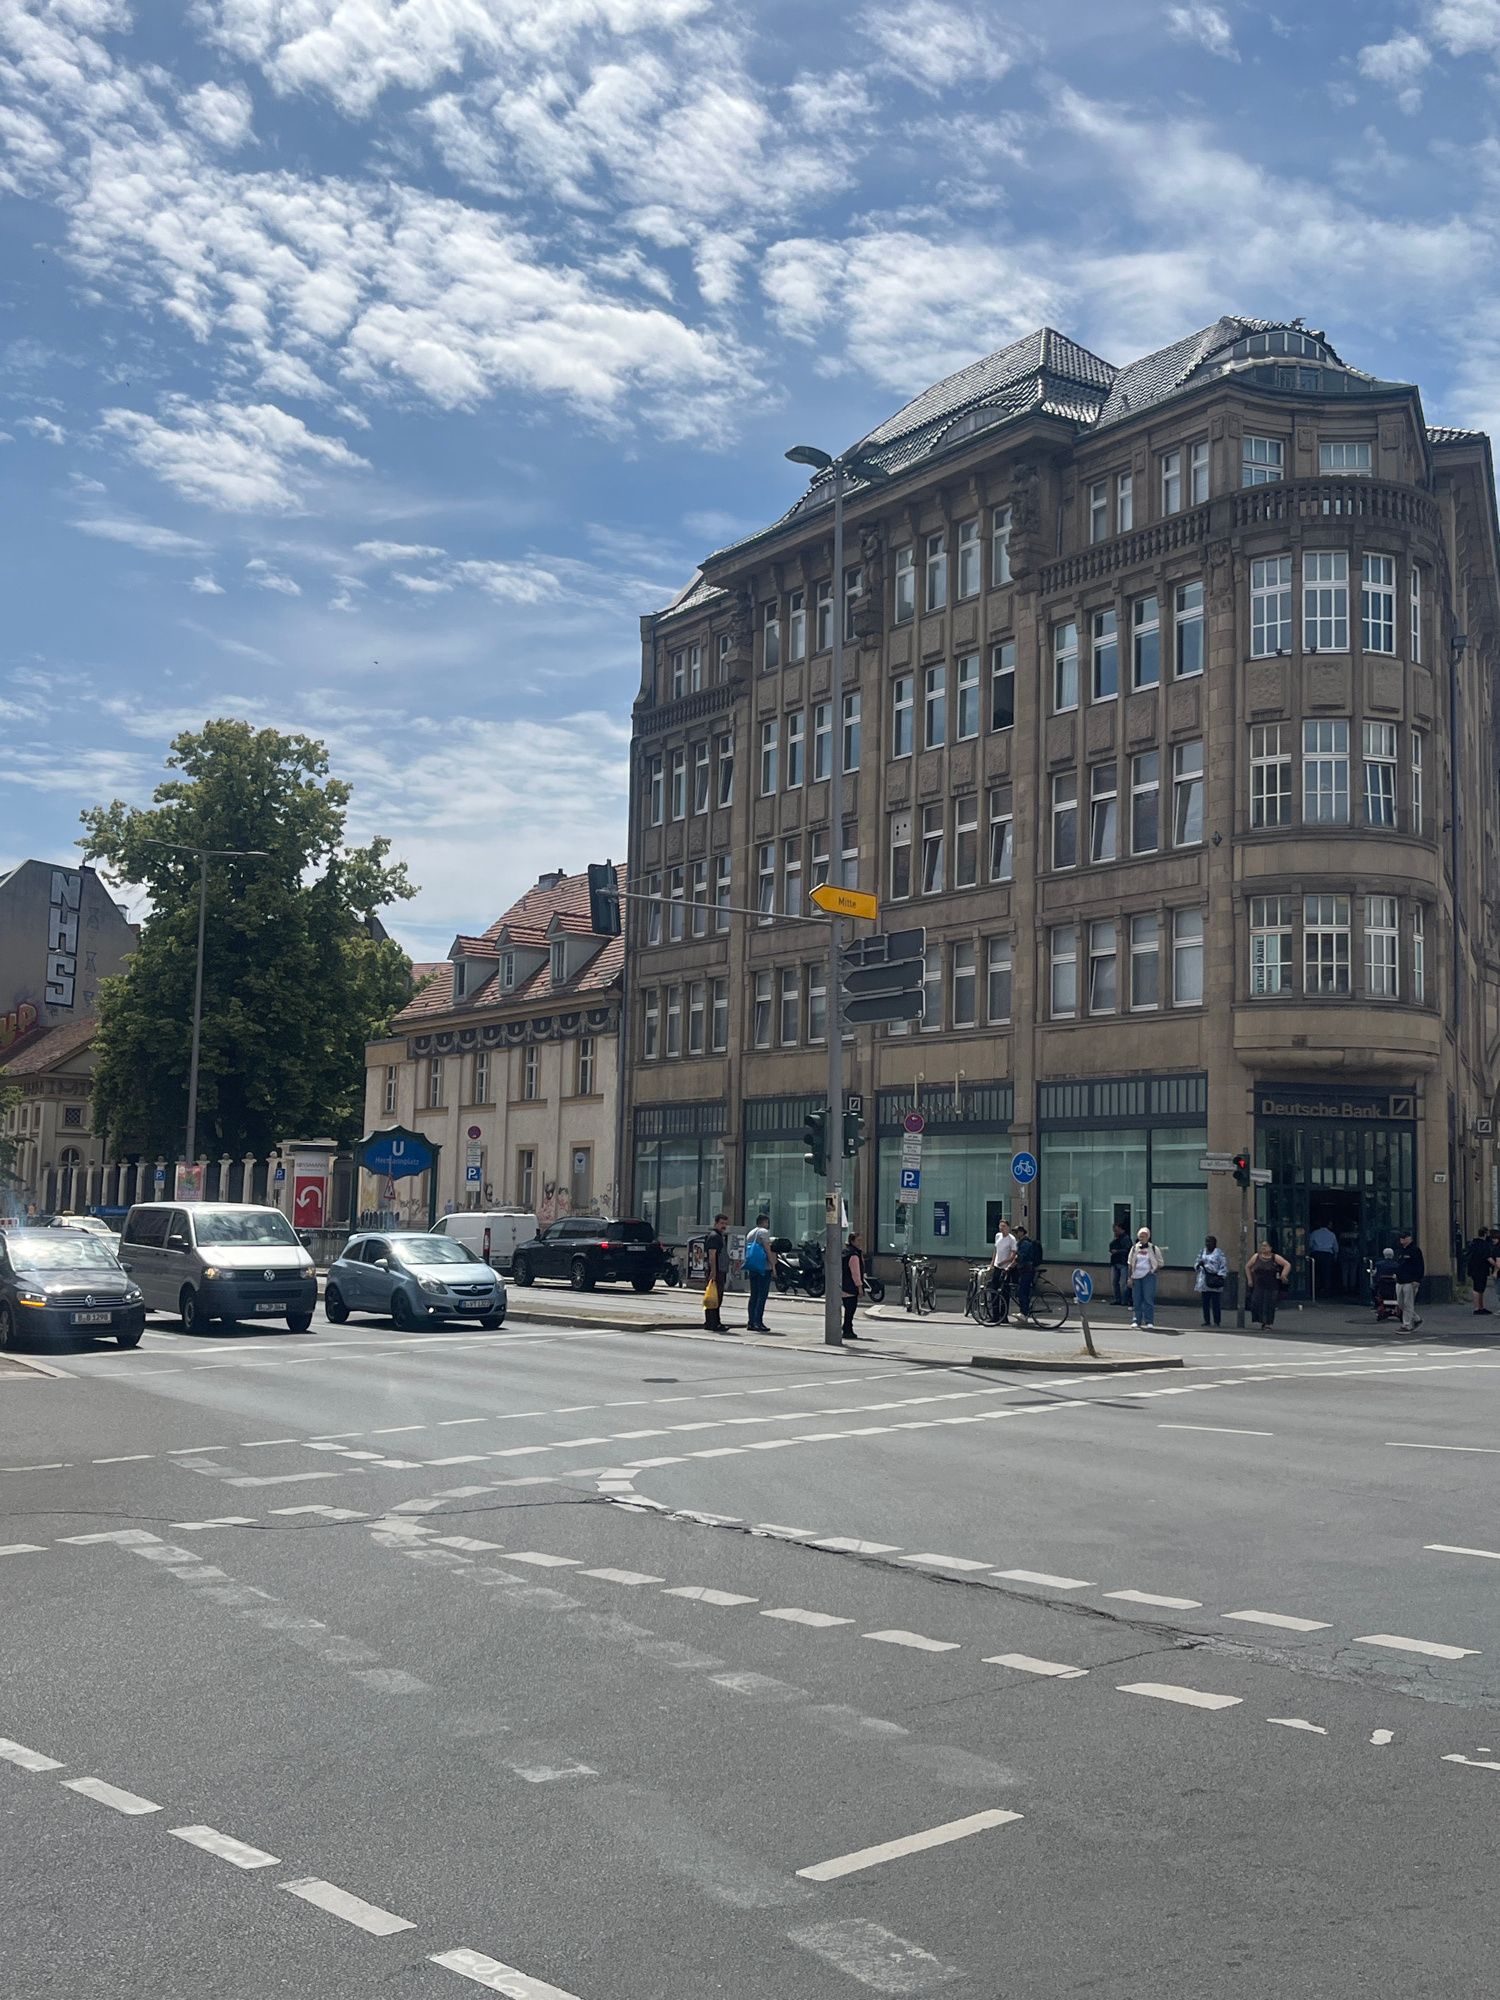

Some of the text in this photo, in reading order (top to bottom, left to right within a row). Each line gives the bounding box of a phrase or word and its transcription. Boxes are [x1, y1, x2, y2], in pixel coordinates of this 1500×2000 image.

[839, 897, 856, 908] Mitte
[1262, 1100, 1382, 1118] Deutsche Bank
[392, 1141, 405, 1156] U
